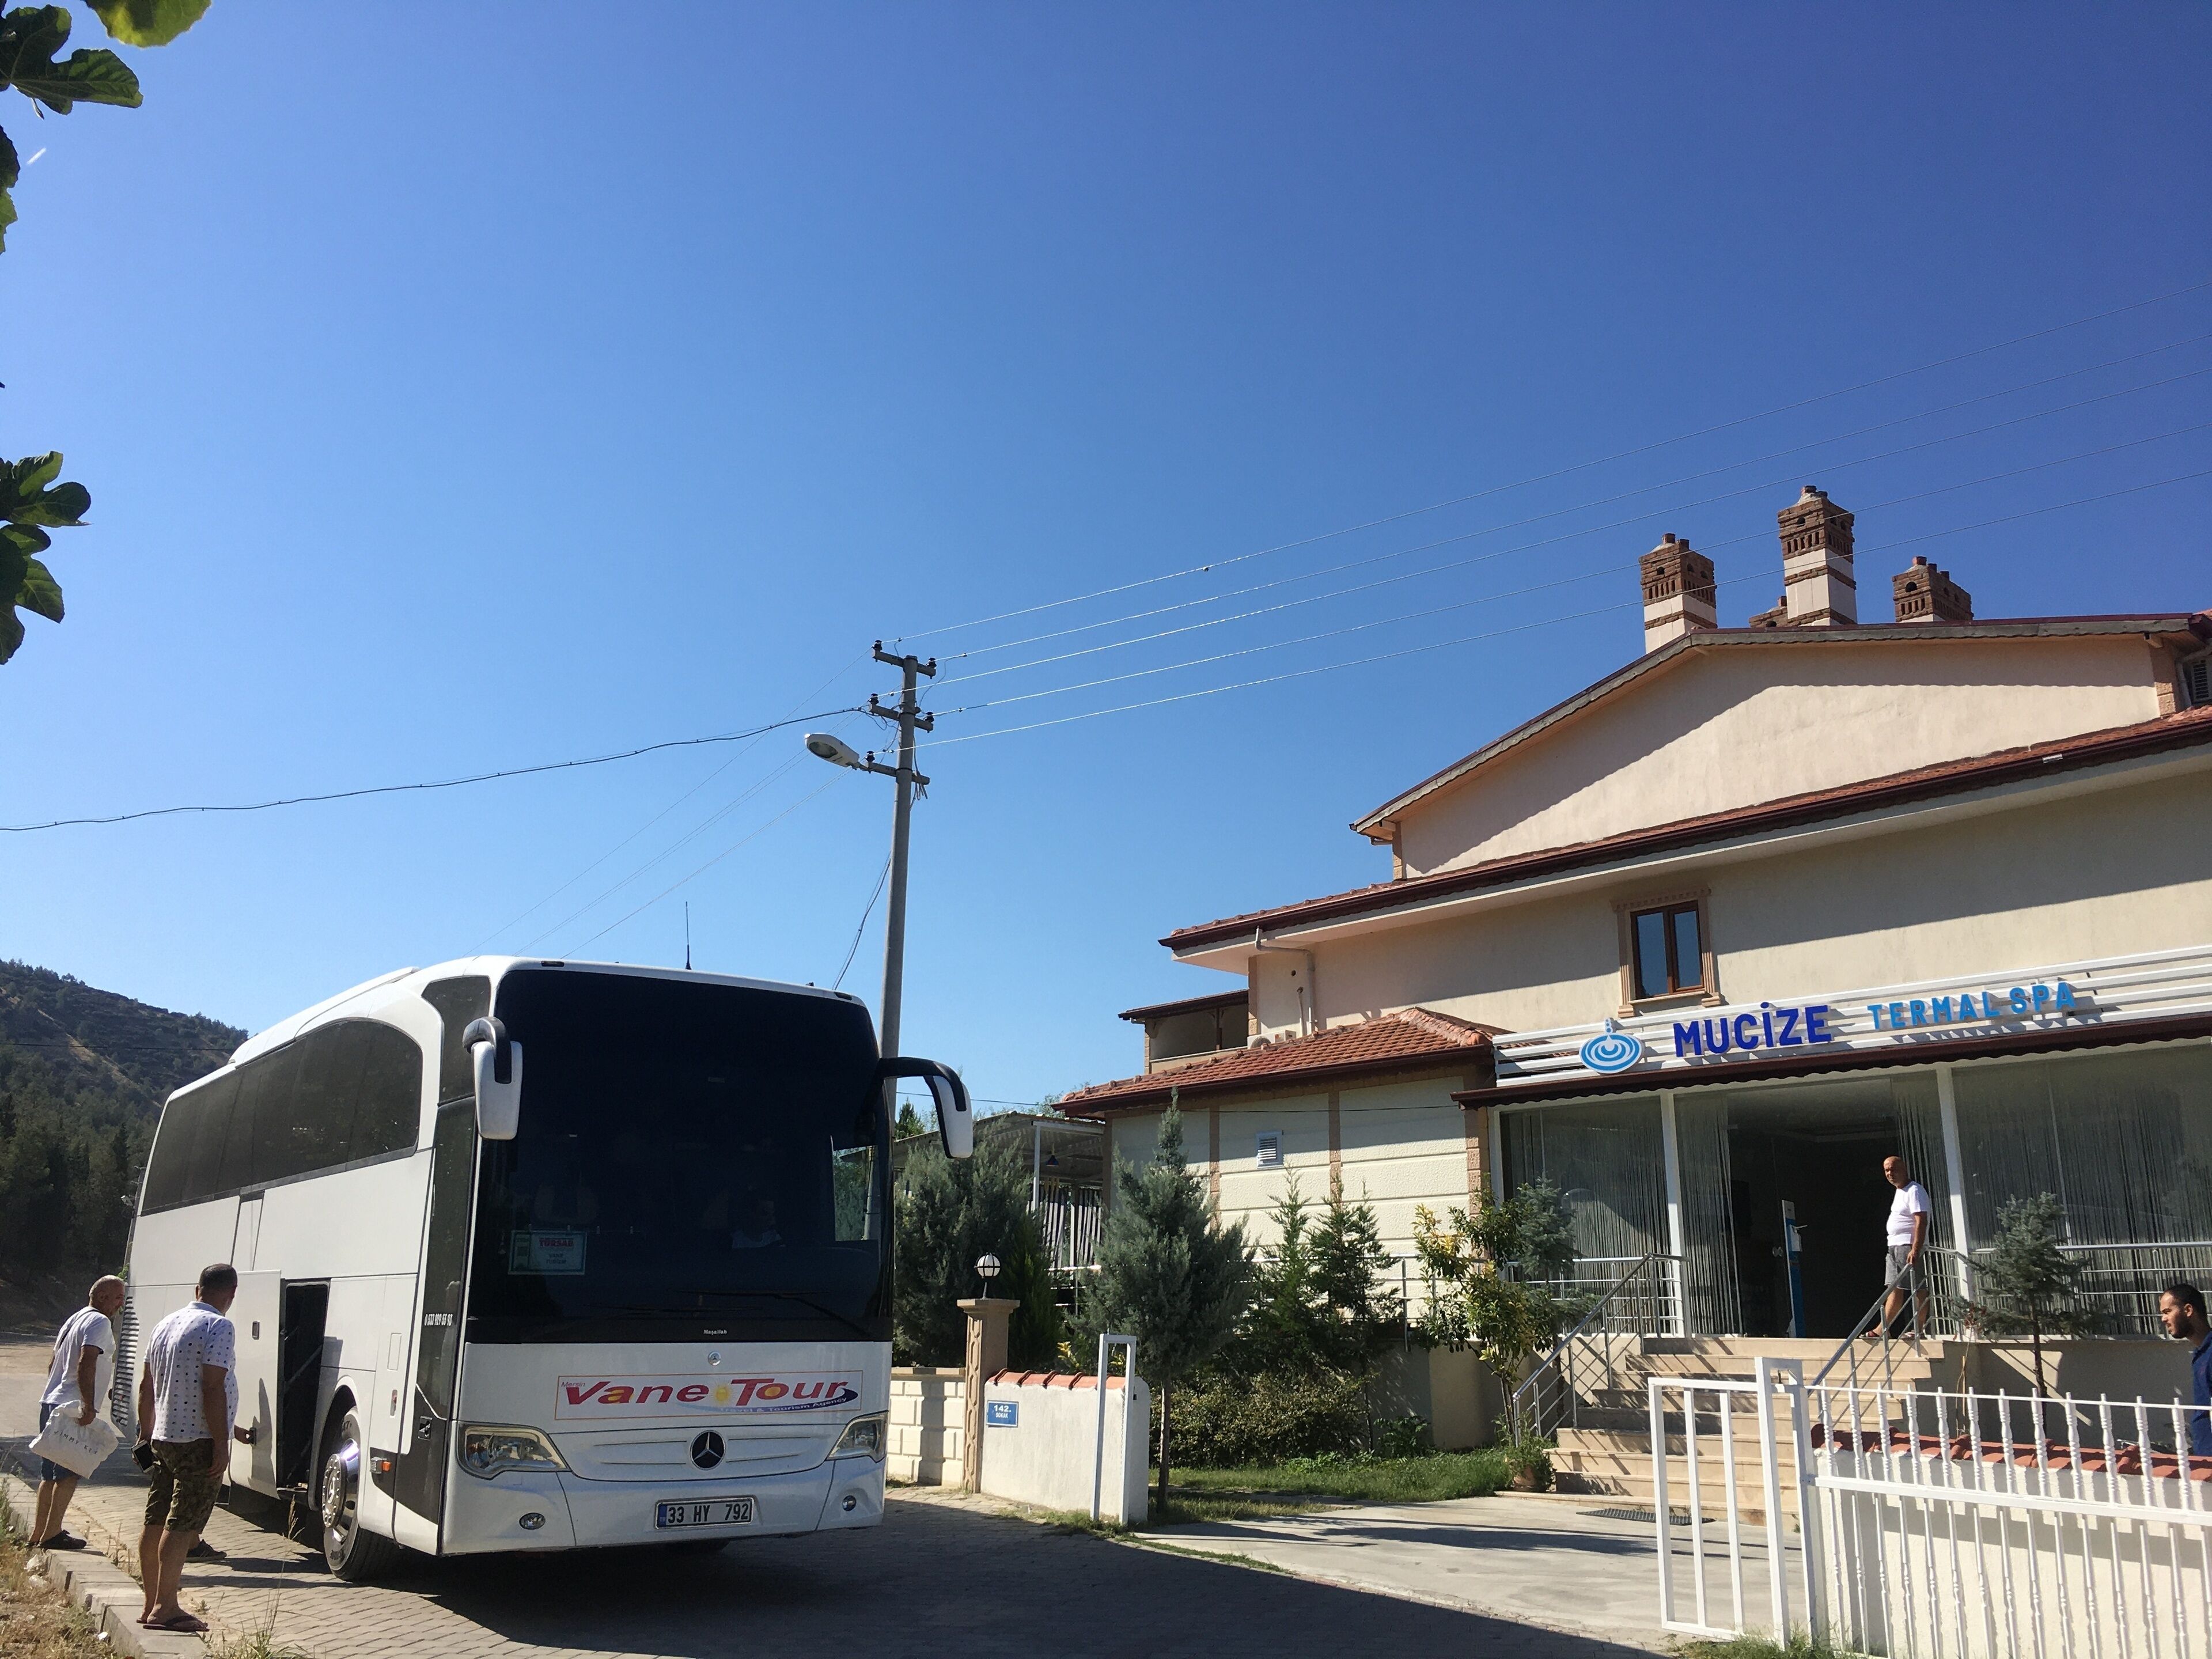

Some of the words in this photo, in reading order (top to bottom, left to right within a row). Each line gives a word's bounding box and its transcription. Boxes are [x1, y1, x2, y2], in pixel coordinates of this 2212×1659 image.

[1867, 991, 2001, 1031] TERMAL
[2009, 981, 2077, 1014] SPA
[1673, 1002, 1832, 1057] MUCİZE
[566, 1381, 709, 1405] Vane
[730, 1378, 849, 1406] Tour
[769, 1404, 810, 1412] Tourism
[812, 1396, 847, 1407] Agency
[54, 1430, 79, 1445] JIMMY
[668, 1506, 684, 1523] 33
[694, 1505, 710, 1522] HY
[725, 1503, 749, 1521] 792
